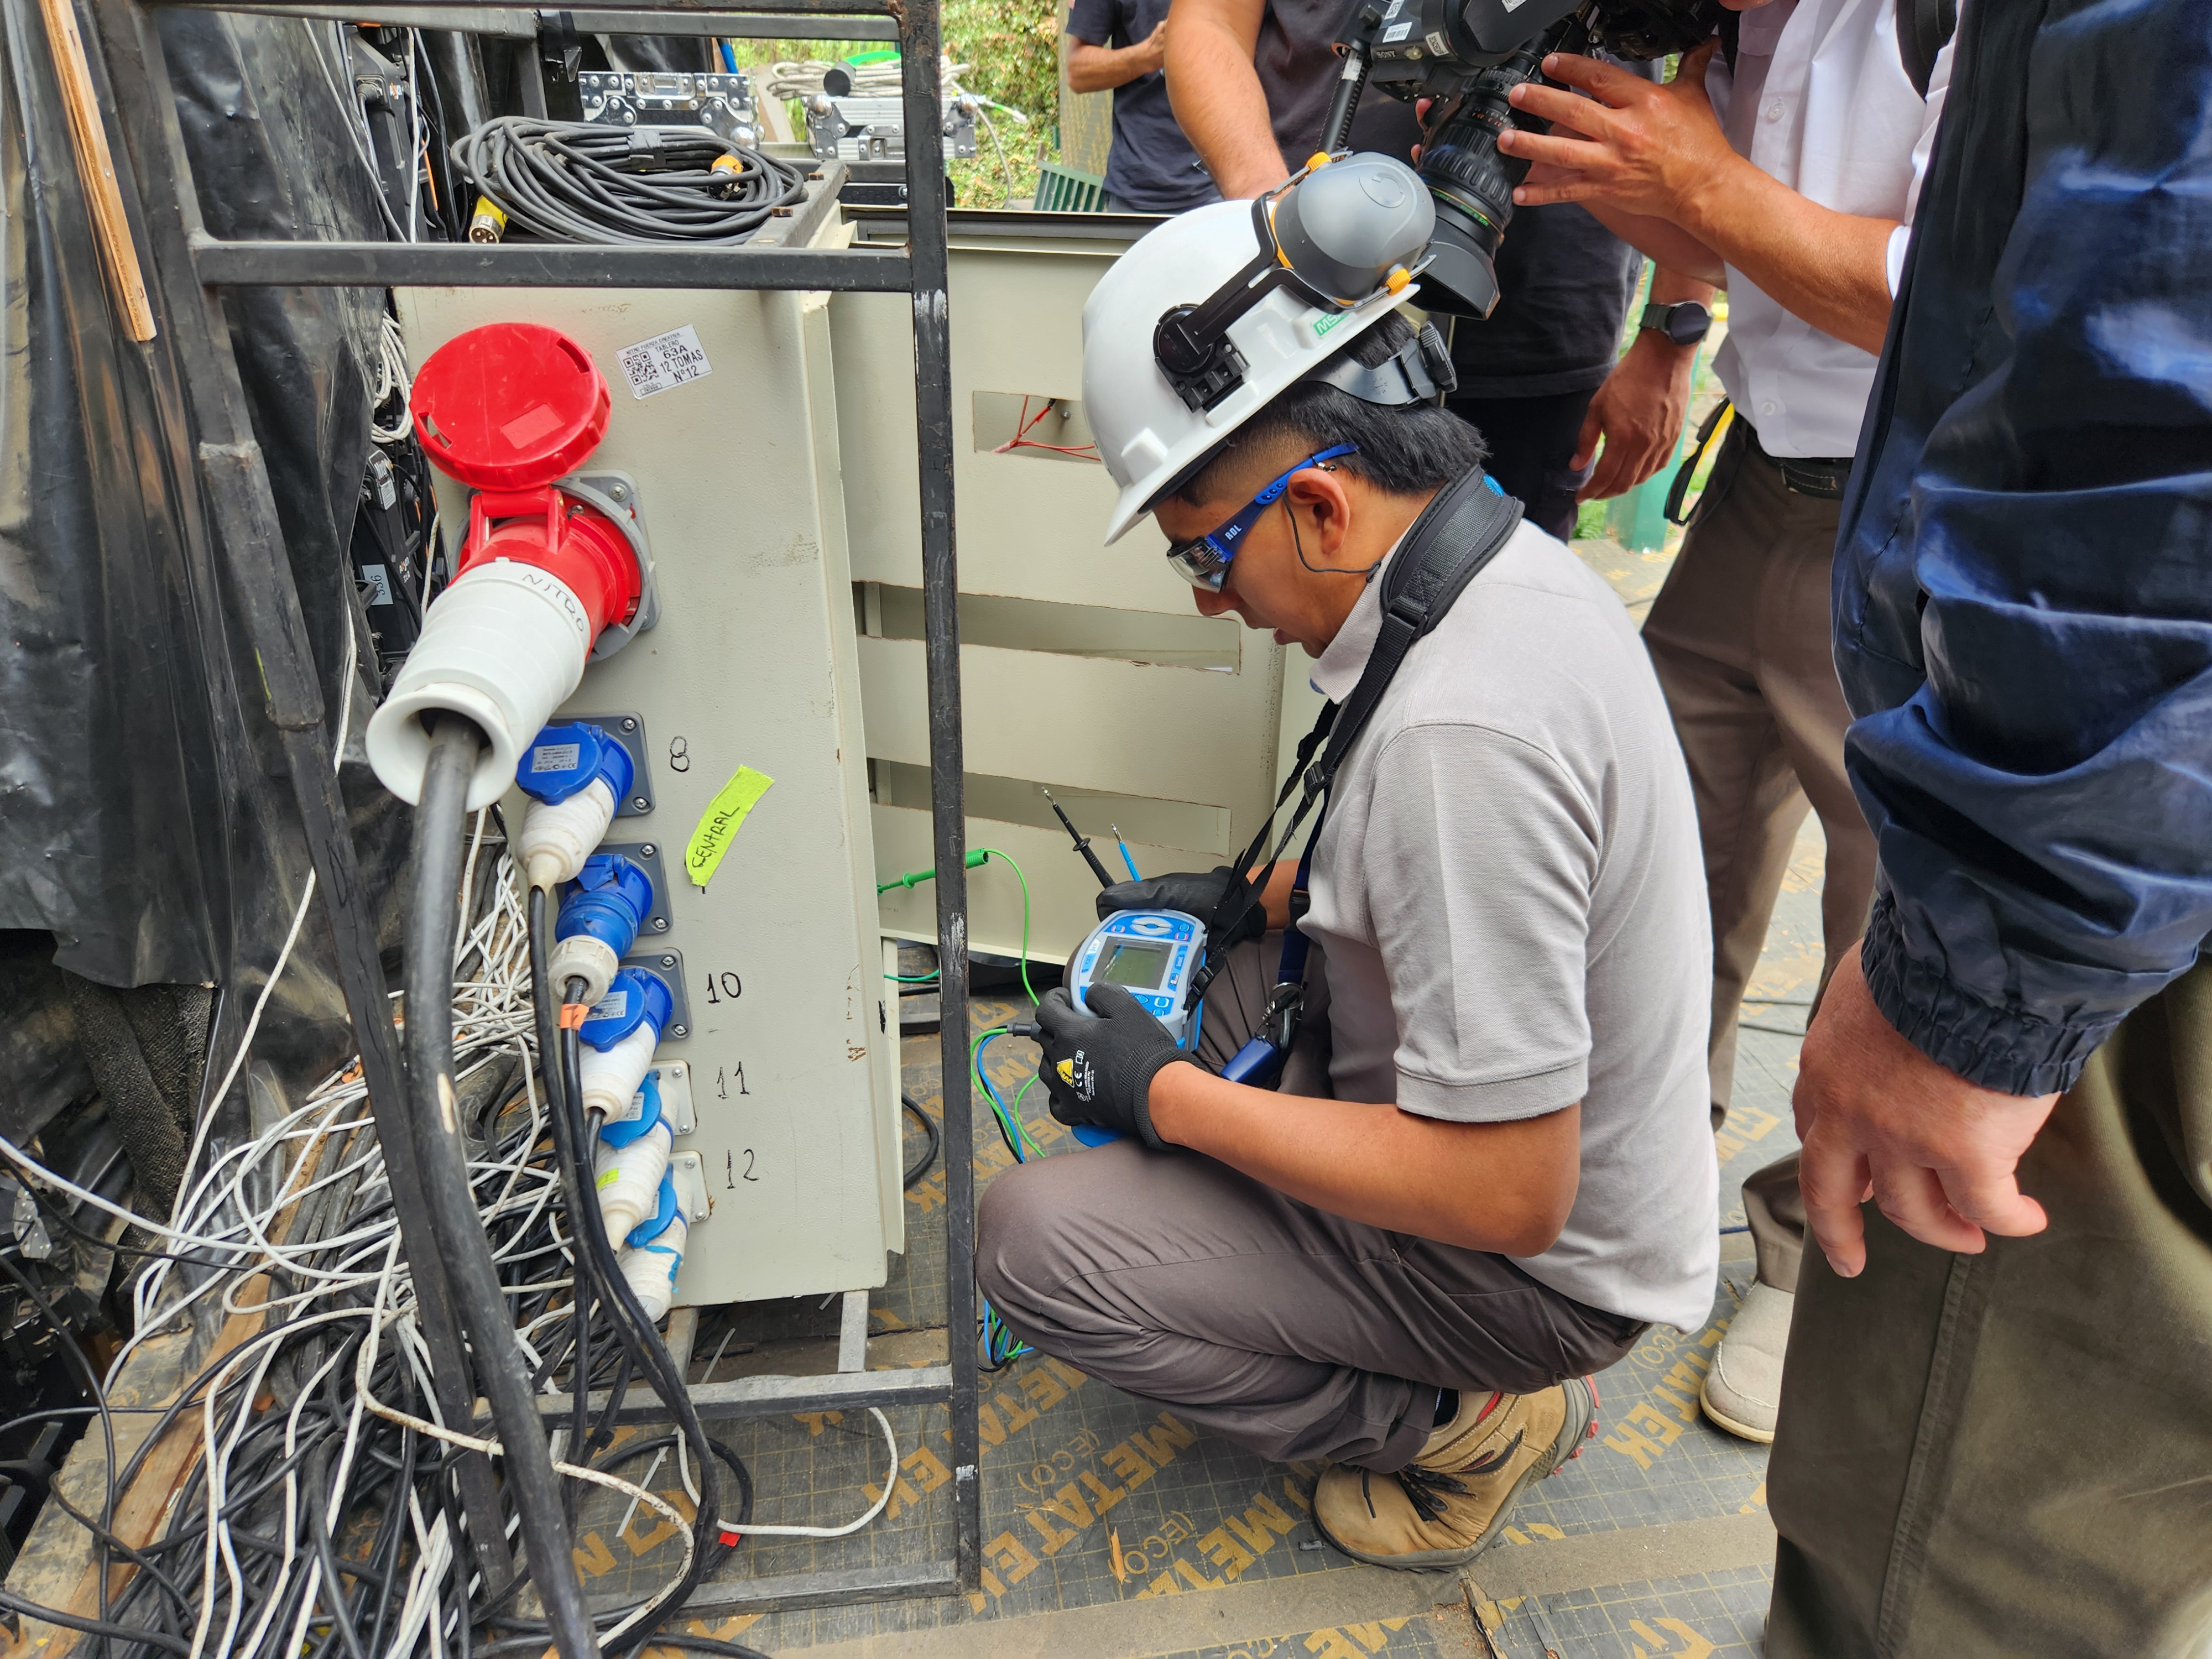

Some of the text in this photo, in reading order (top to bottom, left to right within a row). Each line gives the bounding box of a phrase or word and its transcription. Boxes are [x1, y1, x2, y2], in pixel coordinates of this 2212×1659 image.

[1376, 50, 1396, 59] SONY
[1316, 314, 1341, 334] MS
[655, 340, 680, 352] TABLERO
[660, 349, 703, 373] 12 TOMAS
[663, 345, 688, 359] 63A
[522, 574, 584, 632] NITRO
[670, 736, 690, 773] 8
[692, 806, 740, 868] CENTRAL
[707, 972, 742, 1004] 10
[717, 1061, 751, 1099] 11
[727, 1149, 760, 1188] 12
[1017, 1427, 1100, 1493] (ECO)
